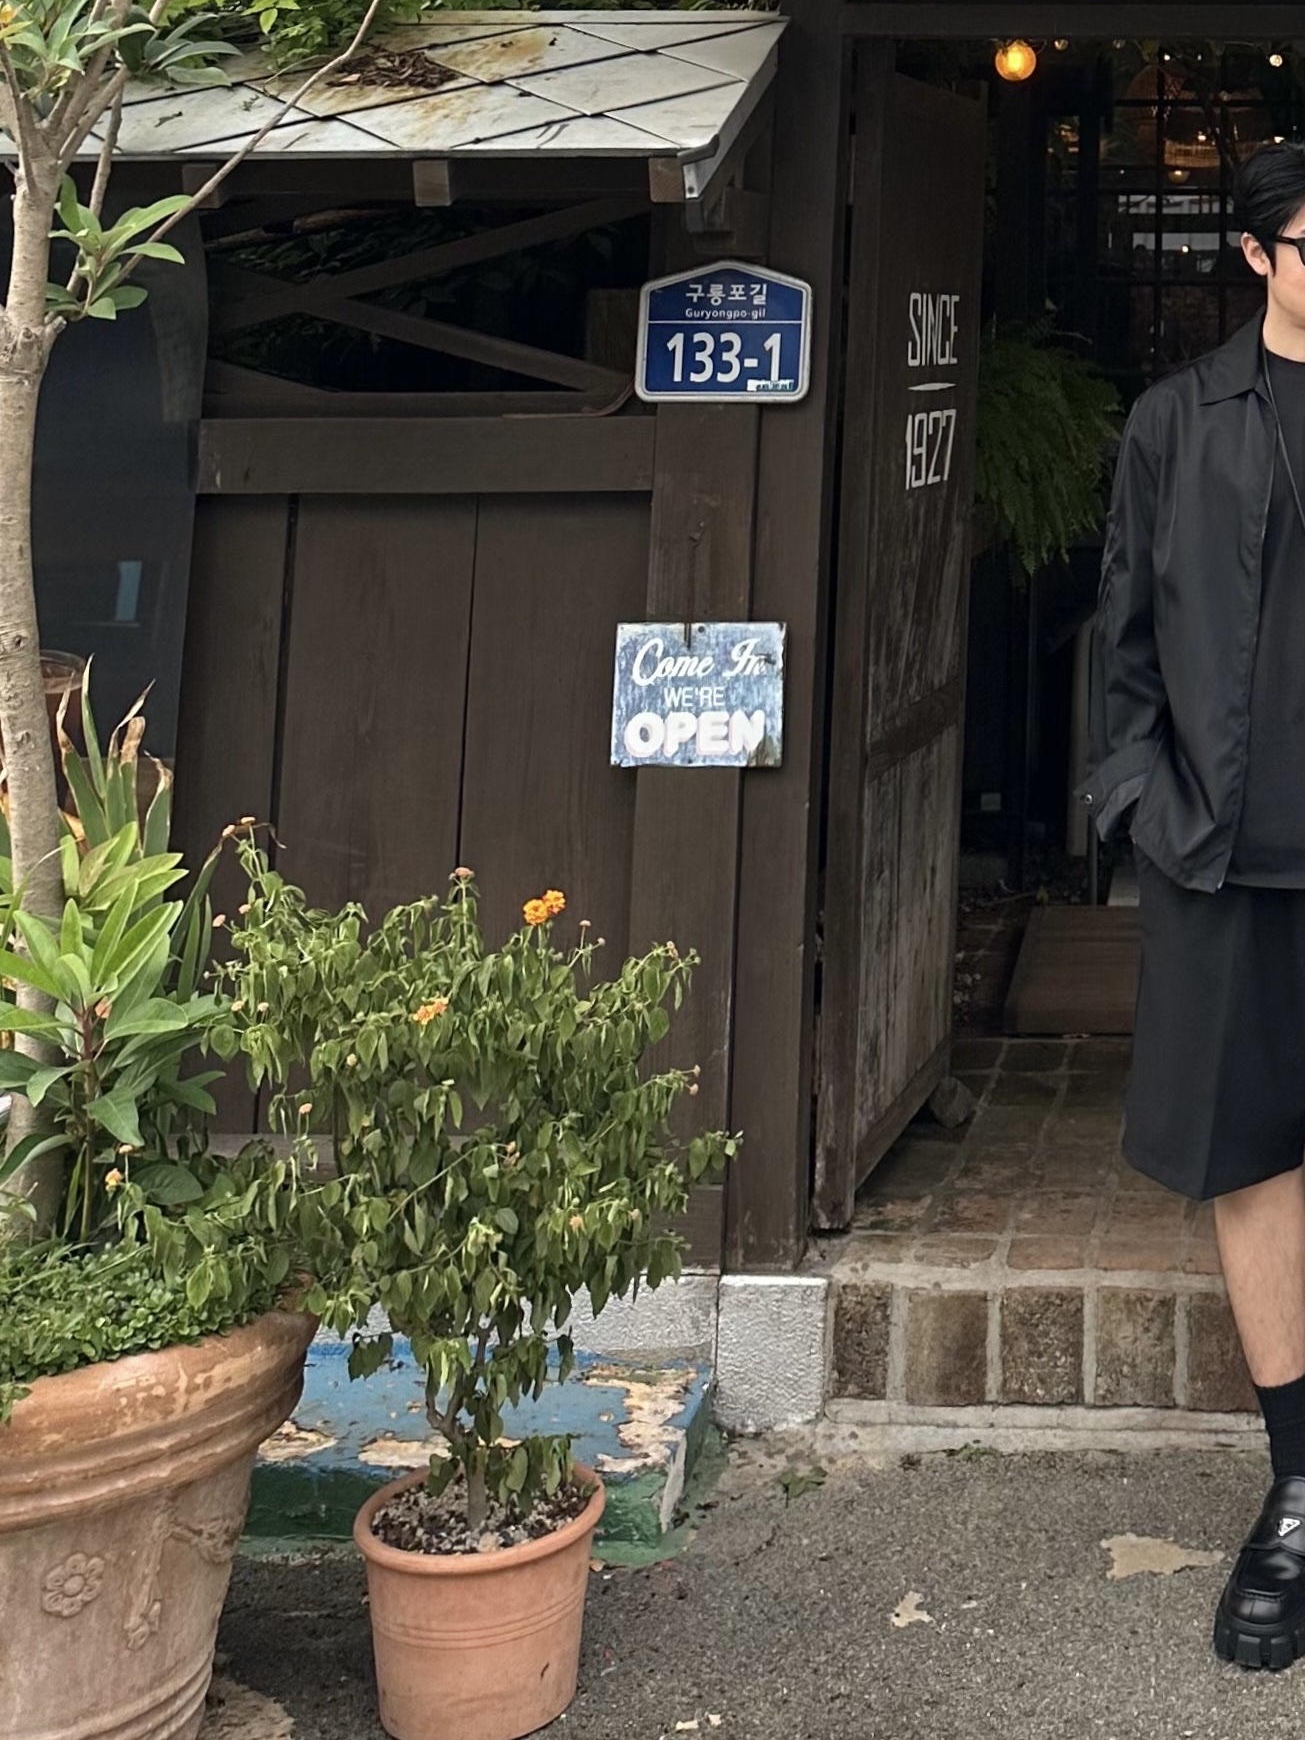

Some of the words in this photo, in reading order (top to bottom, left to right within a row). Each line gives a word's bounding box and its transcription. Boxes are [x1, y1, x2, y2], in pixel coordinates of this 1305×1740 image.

[685, 283, 768, 306] 구룡포길
[685, 307, 767, 320] Guryongpo-gil
[908, 292, 960, 367] SINCE
[666, 332, 782, 383] 133-1
[905, 409, 957, 490] 1927
[632, 637, 715, 687] Come
[664, 686, 726, 709] WE'RE
[624, 710, 765, 757] OPEN
